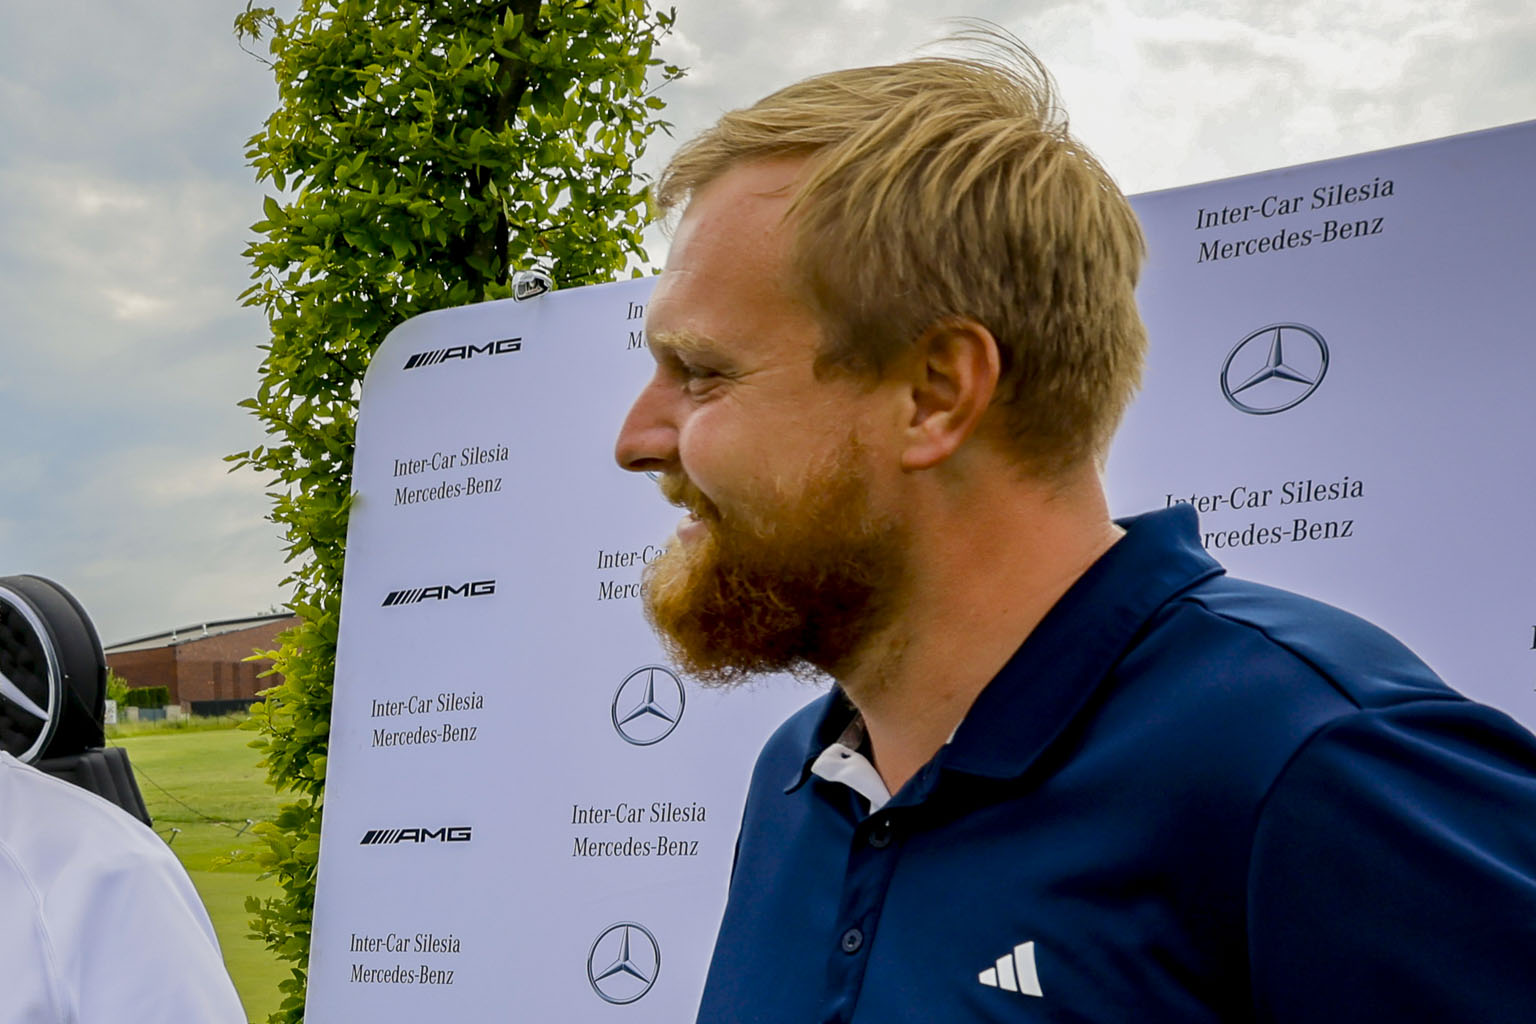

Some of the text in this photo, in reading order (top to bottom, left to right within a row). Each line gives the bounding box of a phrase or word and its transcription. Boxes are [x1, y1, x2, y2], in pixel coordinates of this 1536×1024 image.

[1195, 177, 1395, 231] Inter-Car Silesia
[1197, 214, 1384, 264] Mercedes-Benz
[443, 337, 522, 361] AMG
[392, 443, 510, 478] Inter-Car Silesia
[393, 475, 503, 506] Mercedes-Benz
[1280, 476, 1364, 505] Silesia
[1204, 518, 1354, 549] rcedes-Benz
[597, 545, 668, 570] Inter-Ca
[417, 580, 496, 602] AMG
[370, 691, 484, 718] Inter-Car Silesia
[371, 722, 478, 748] Mercedes-Benz
[571, 801, 707, 825] Inter-Car Silesia
[396, 826, 472, 844] AMG
[572, 835, 699, 857] Mercedes-Benz
[349, 933, 461, 954] Inter-Car Silesia
[350, 964, 454, 985] Mercedes-Benz
